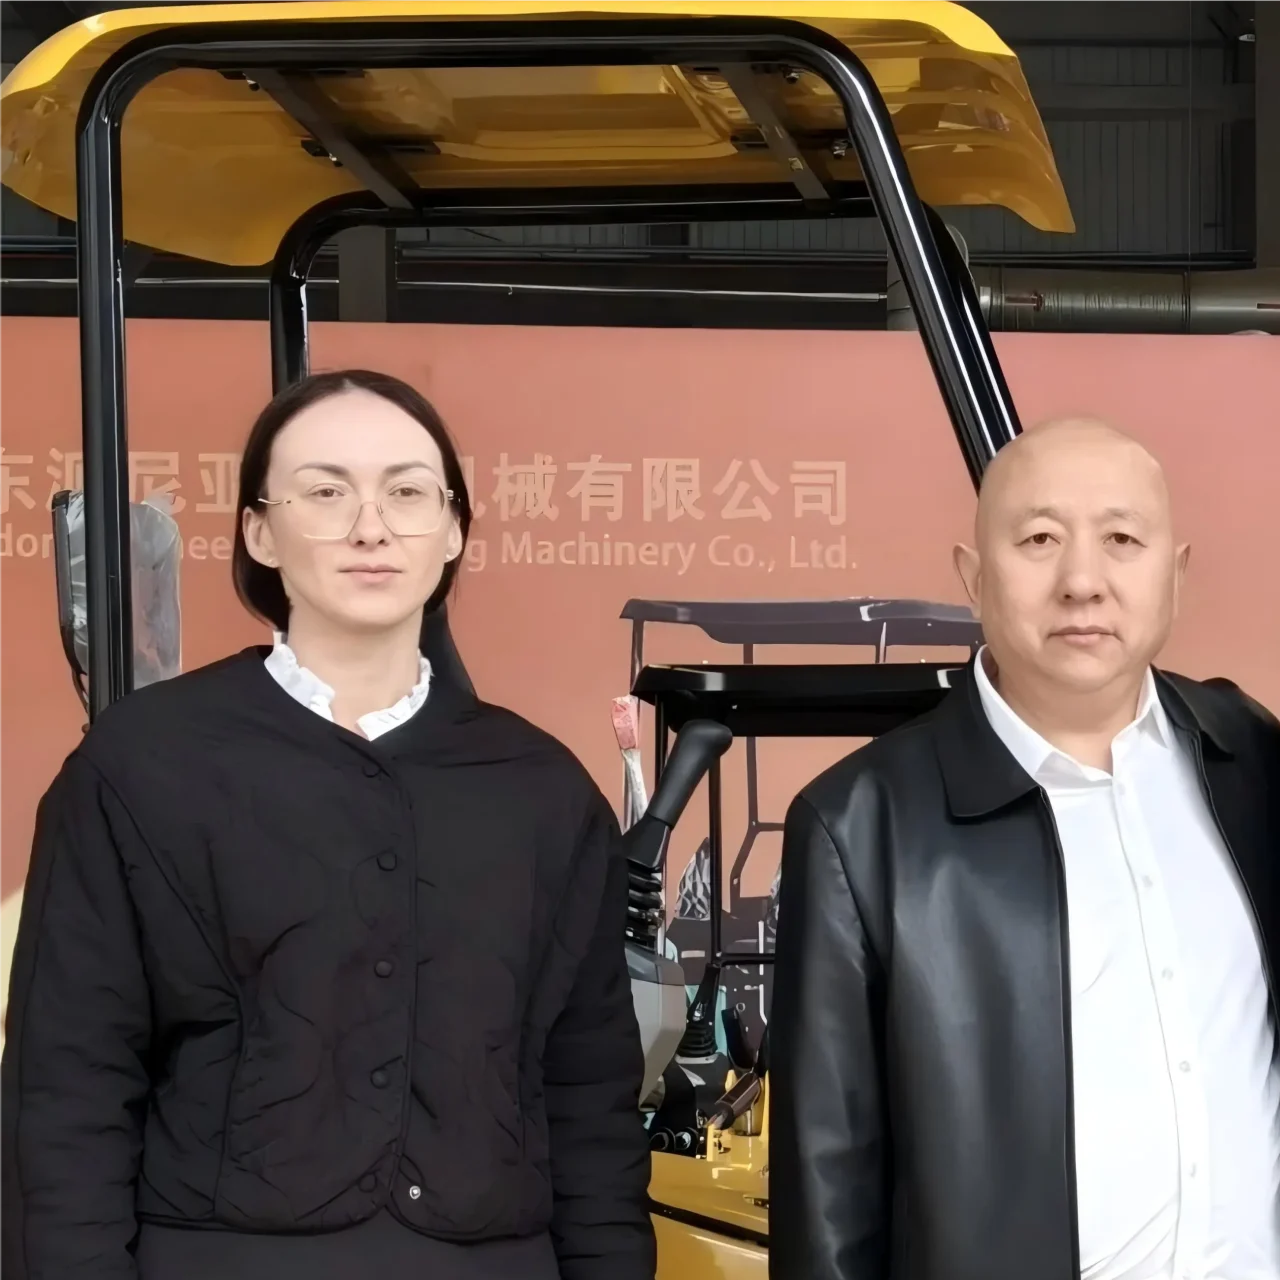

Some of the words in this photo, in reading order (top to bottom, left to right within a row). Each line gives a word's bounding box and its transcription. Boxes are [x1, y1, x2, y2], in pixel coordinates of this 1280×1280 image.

[500, 531, 697, 576] Machinery
[707, 534, 776, 574] Co.,
[789, 534, 858, 569] Ltd.
